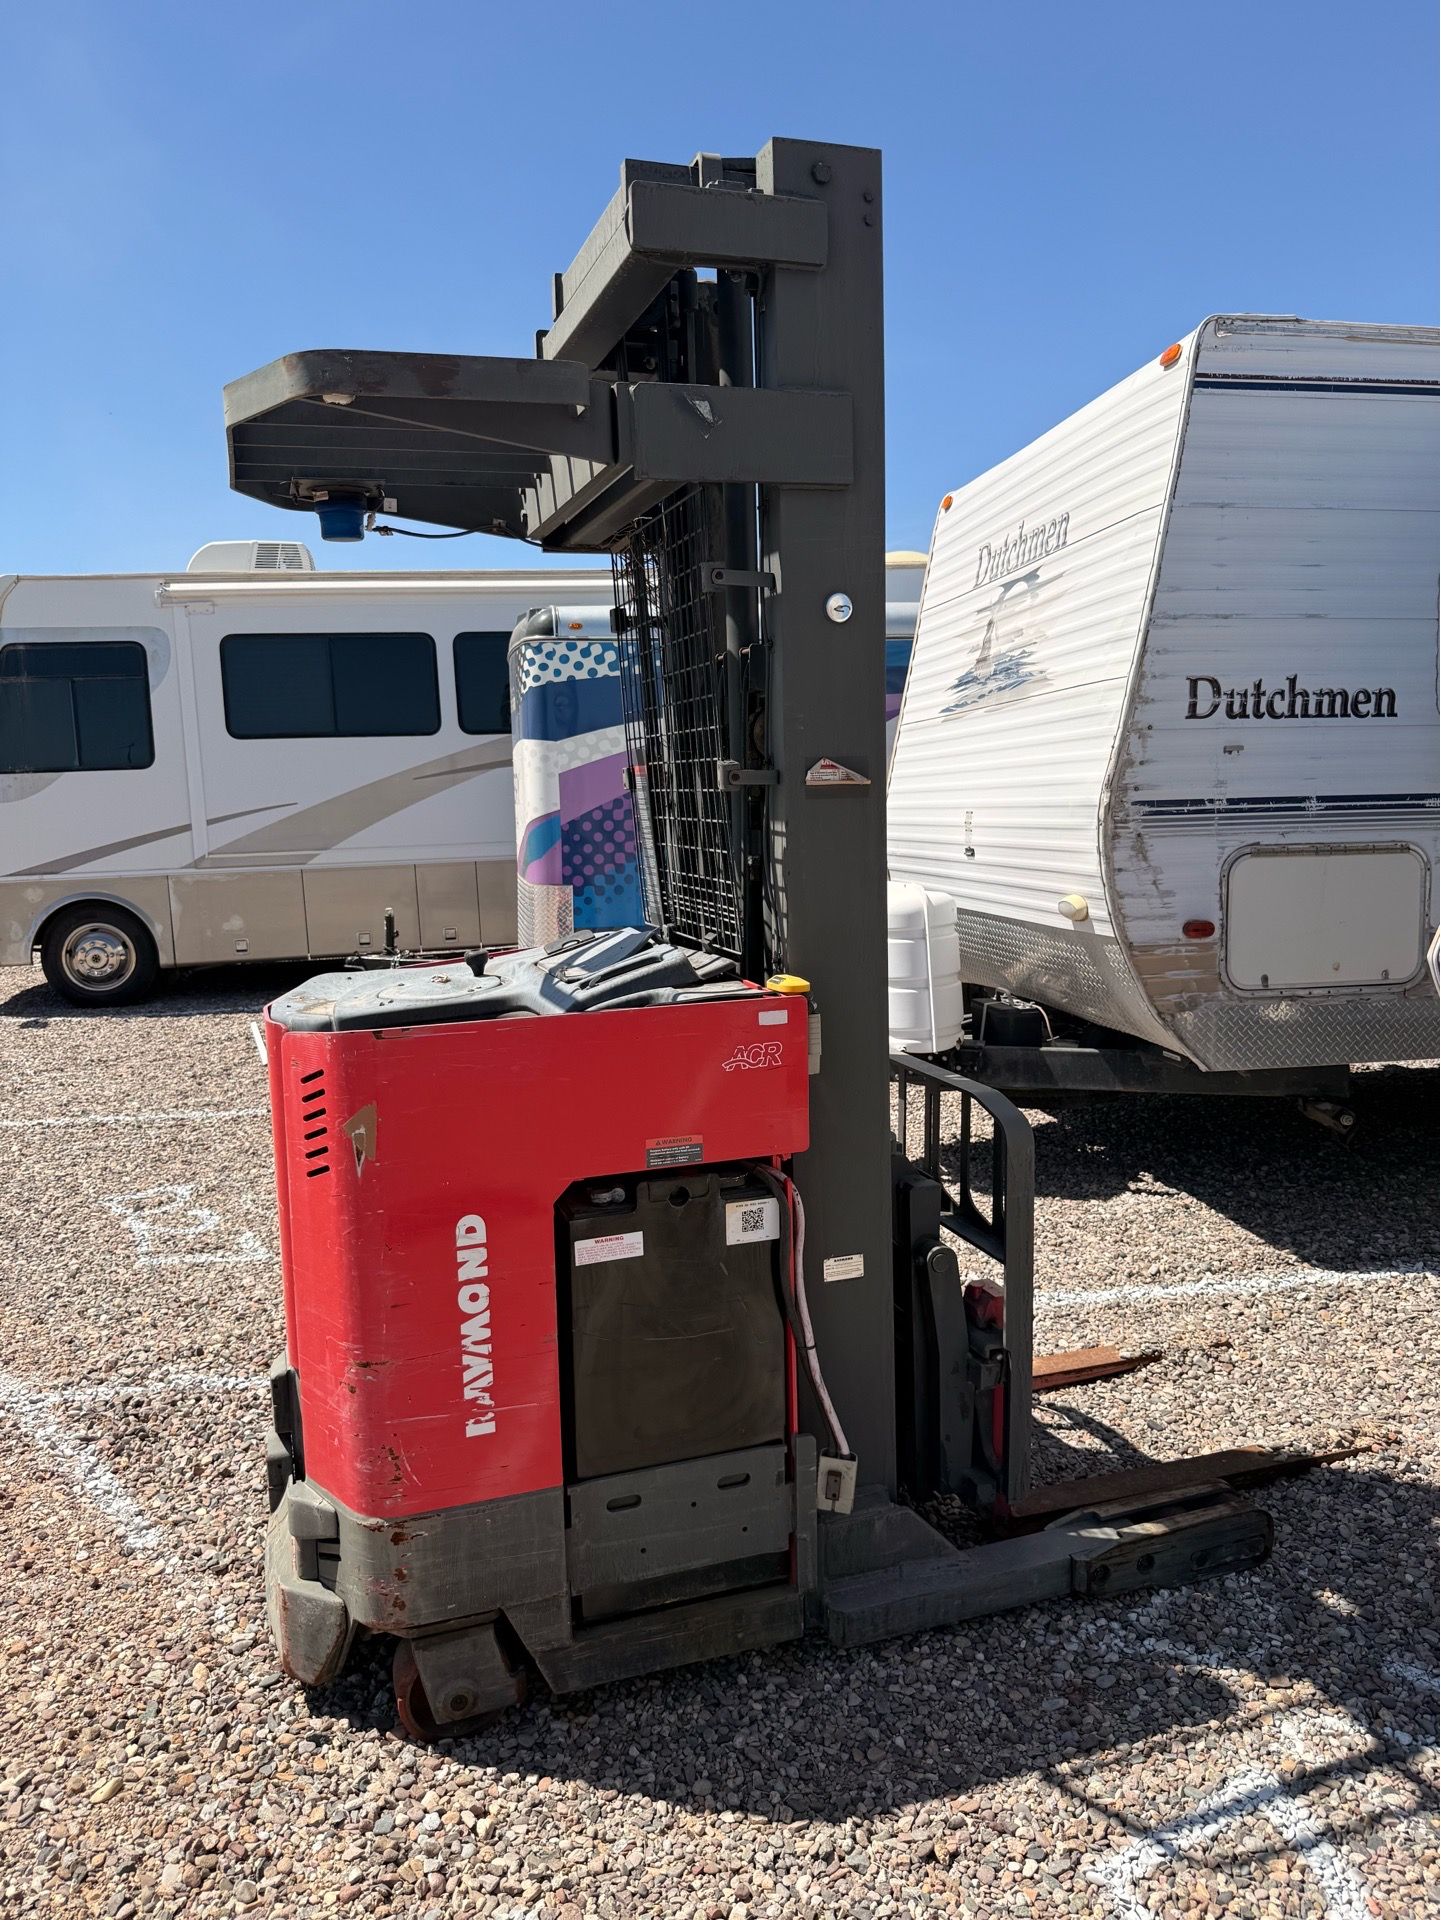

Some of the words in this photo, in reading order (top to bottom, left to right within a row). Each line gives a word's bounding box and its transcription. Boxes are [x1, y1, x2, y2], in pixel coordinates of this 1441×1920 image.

[973, 511, 1070, 588] Dutchmen
[1185, 673, 1398, 719] Dutchmen
[722, 1041, 783, 1071] ACR
[661, 1136, 693, 1145] WARNING
[594, 1235, 624, 1245] WARNING
[455, 1214, 496, 1438] RAYMOND
